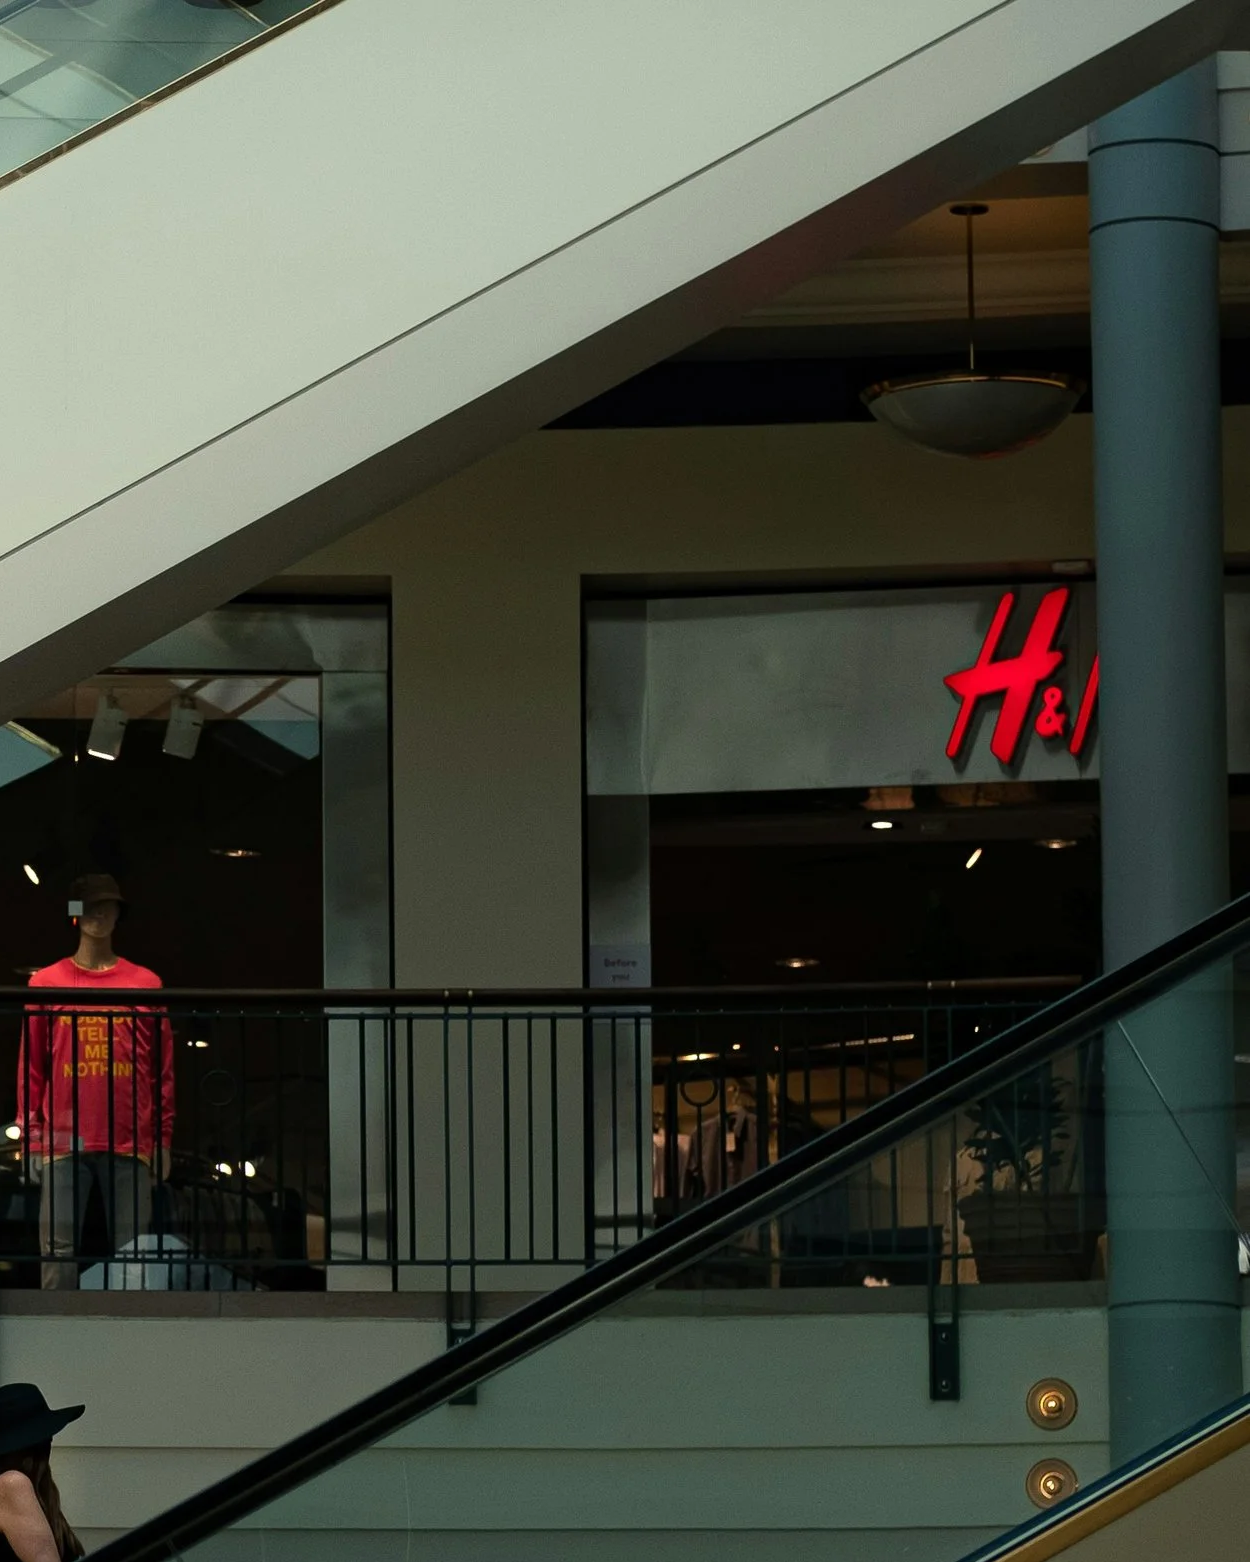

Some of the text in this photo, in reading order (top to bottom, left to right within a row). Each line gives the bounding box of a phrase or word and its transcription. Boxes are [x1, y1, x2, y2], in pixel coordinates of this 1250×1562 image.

[943, 585, 1099, 765] H&
[604, 958, 637, 968] Before
[84, 1044, 110, 1059] ME
[63, 1060, 134, 1077] NOTHIN
